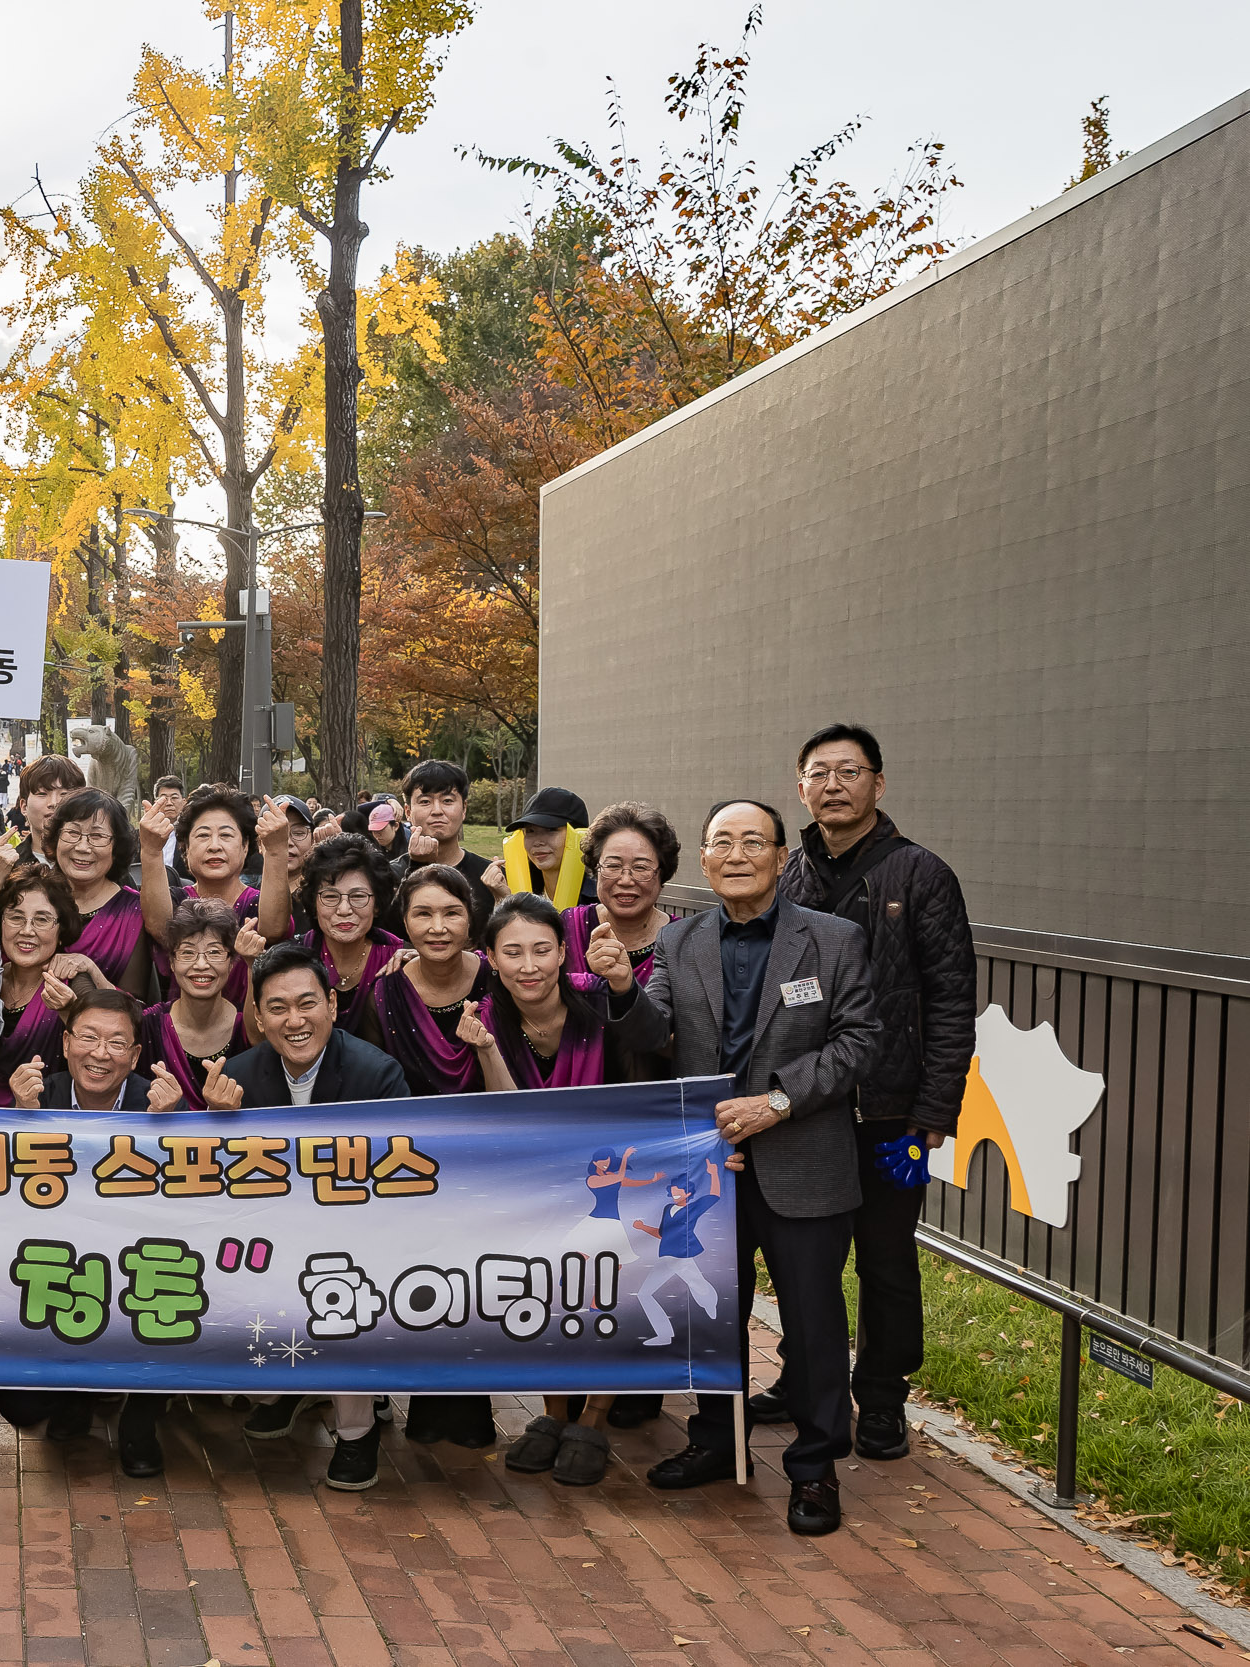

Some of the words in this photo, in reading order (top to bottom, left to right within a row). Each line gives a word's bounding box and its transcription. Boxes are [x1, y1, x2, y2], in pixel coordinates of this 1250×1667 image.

[9, 1237, 274, 1345] 청춘"
[299, 1249, 620, 1341] 화이팅!!
[1092, 1338, 1120, 1362] 눈으로만
[1121, 1352, 1150, 1377] 봐주세요
